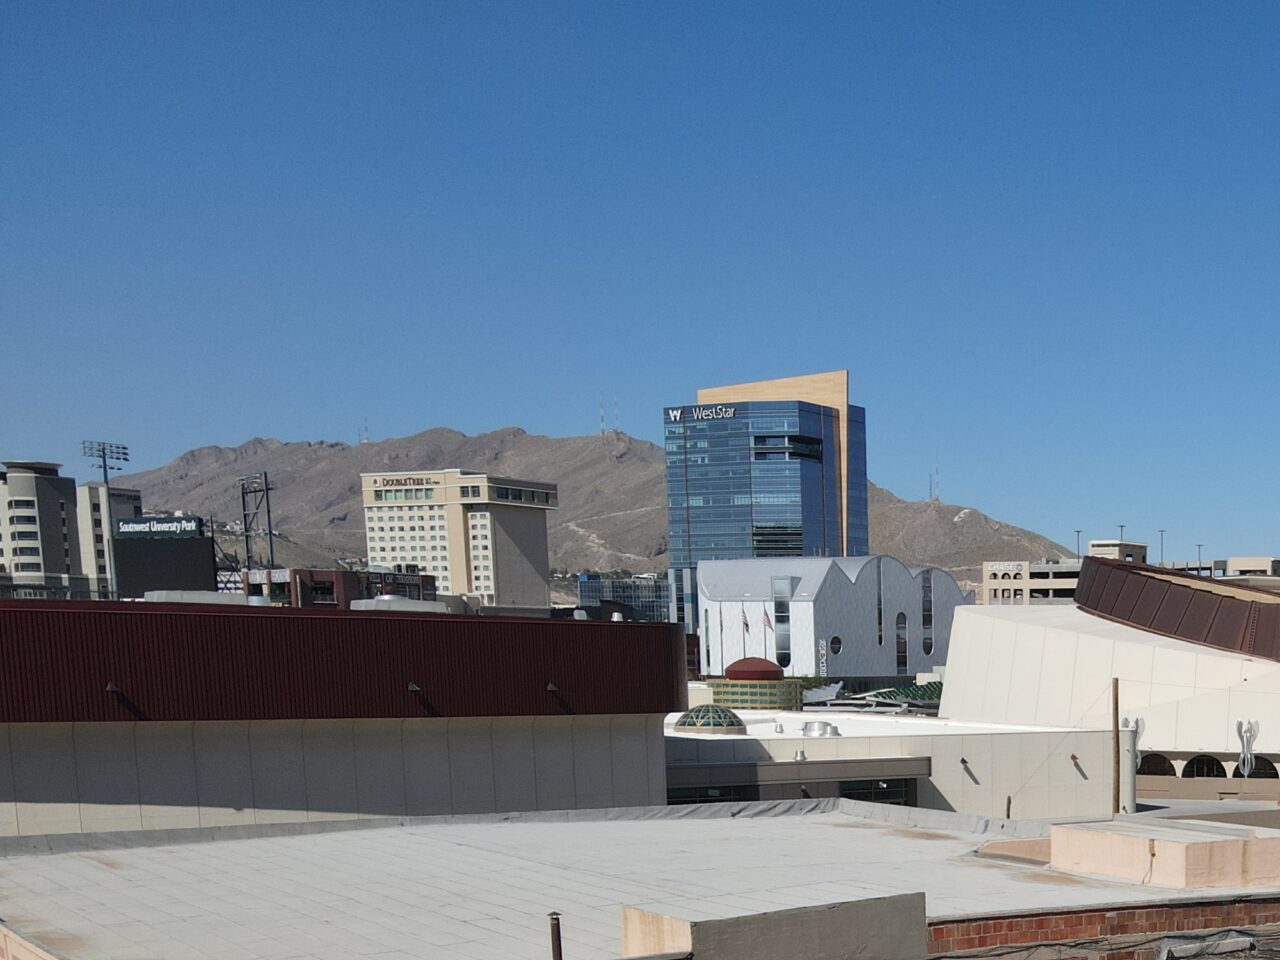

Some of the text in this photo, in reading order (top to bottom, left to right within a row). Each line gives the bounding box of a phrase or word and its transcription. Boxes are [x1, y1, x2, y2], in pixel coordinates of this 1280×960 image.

[692, 405, 735, 420] WestStar
[119, 520, 196, 534] Southwest University Park
